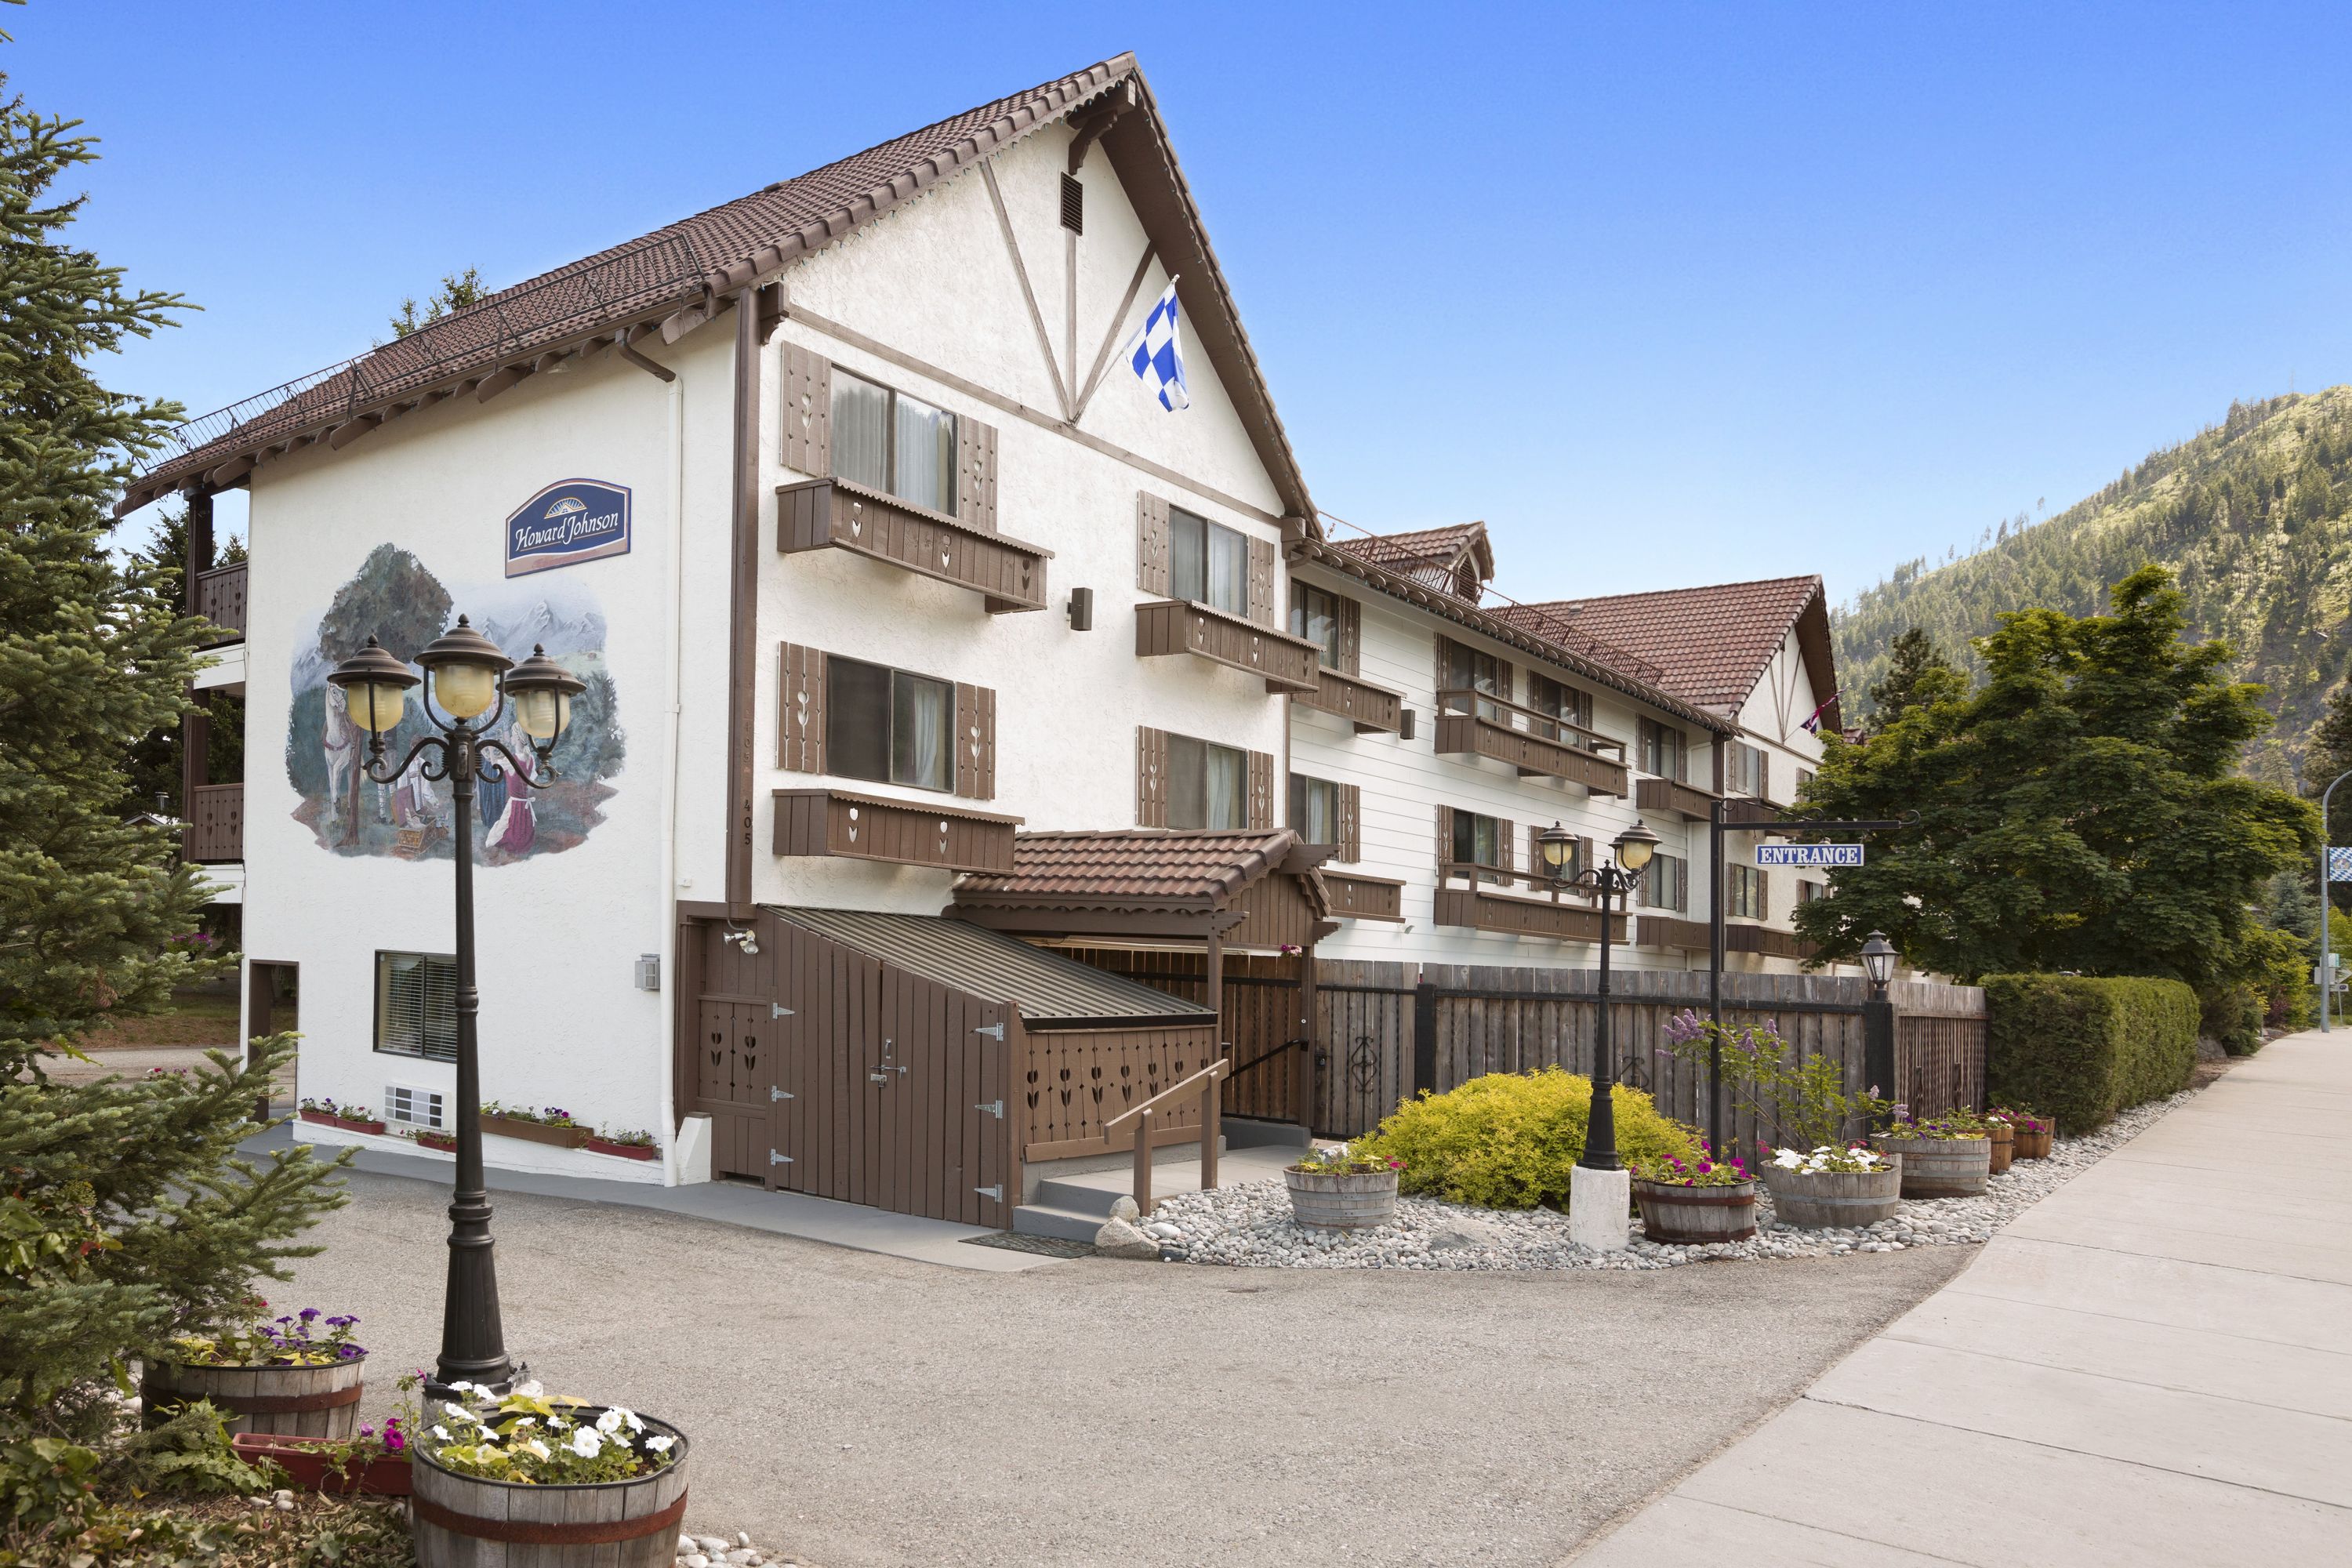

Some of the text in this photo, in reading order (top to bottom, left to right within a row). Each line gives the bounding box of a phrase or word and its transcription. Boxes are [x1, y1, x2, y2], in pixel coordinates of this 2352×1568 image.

[515, 512, 619, 551] Howard Johnson
[743, 799, 752, 845] 405
[1760, 848, 1858, 864] ENTRANCE
